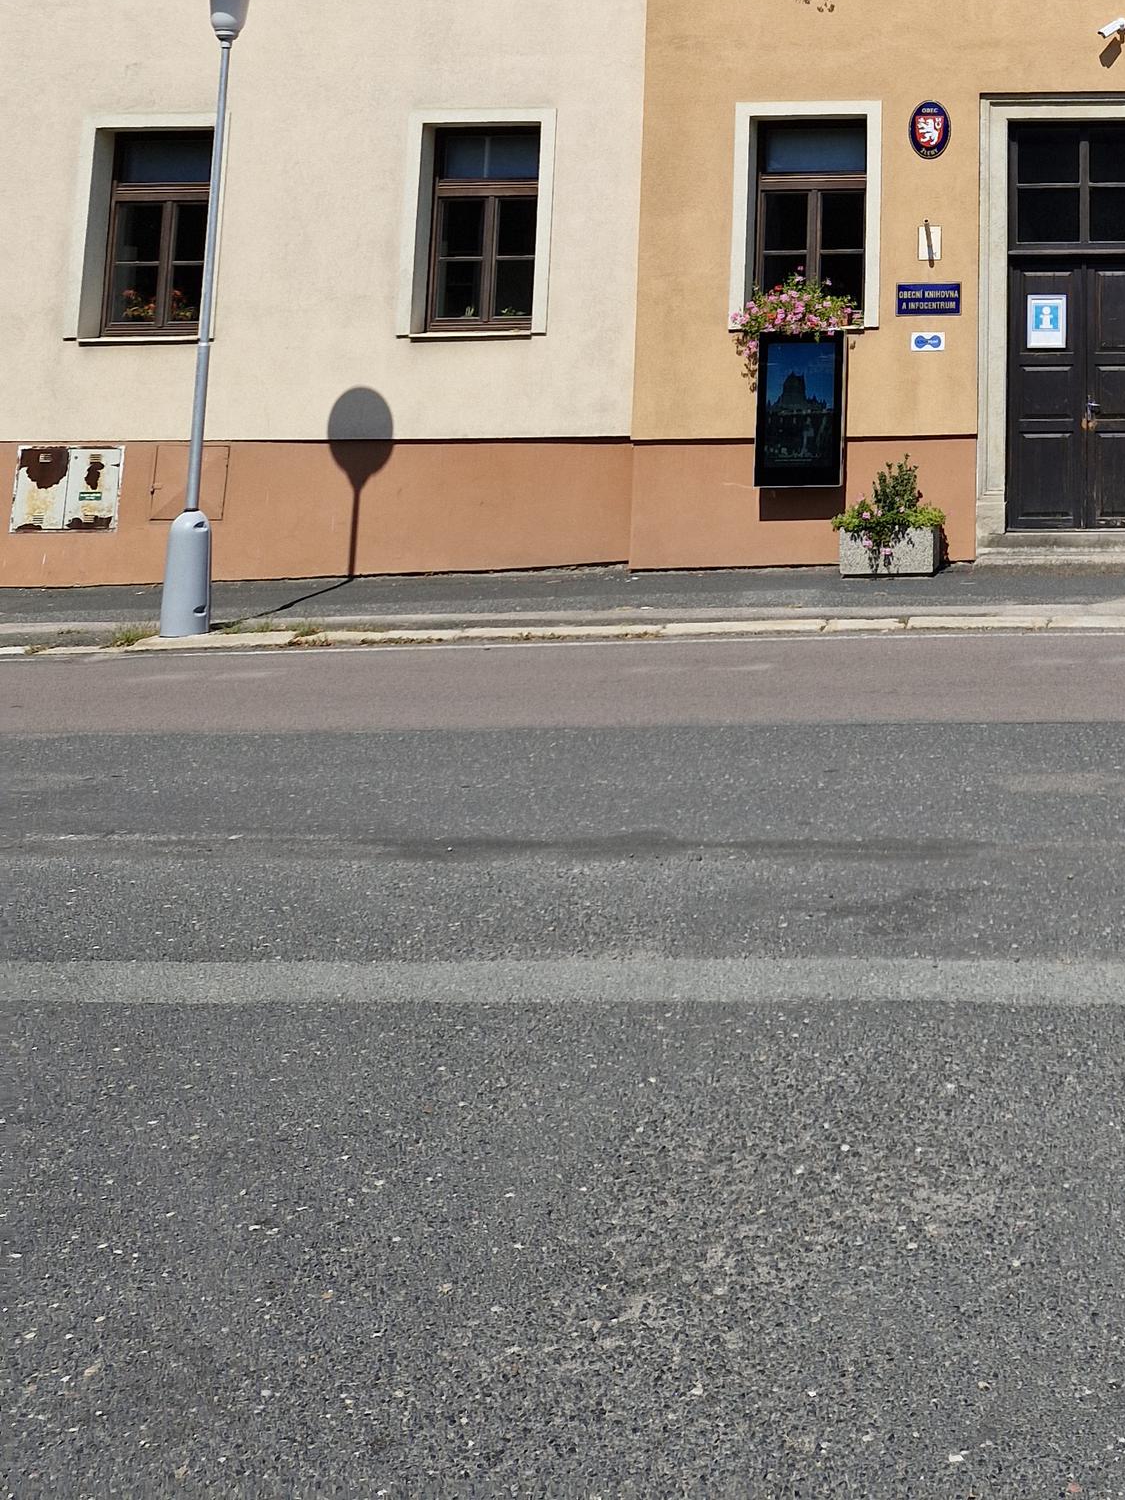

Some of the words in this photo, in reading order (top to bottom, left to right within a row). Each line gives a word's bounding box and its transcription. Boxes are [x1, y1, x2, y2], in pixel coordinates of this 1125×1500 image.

[899, 289, 923, 299] OBECNÍ
[925, 290, 959, 298] KNIHOVNA
[908, 301, 956, 310] INFOCENTRUM
